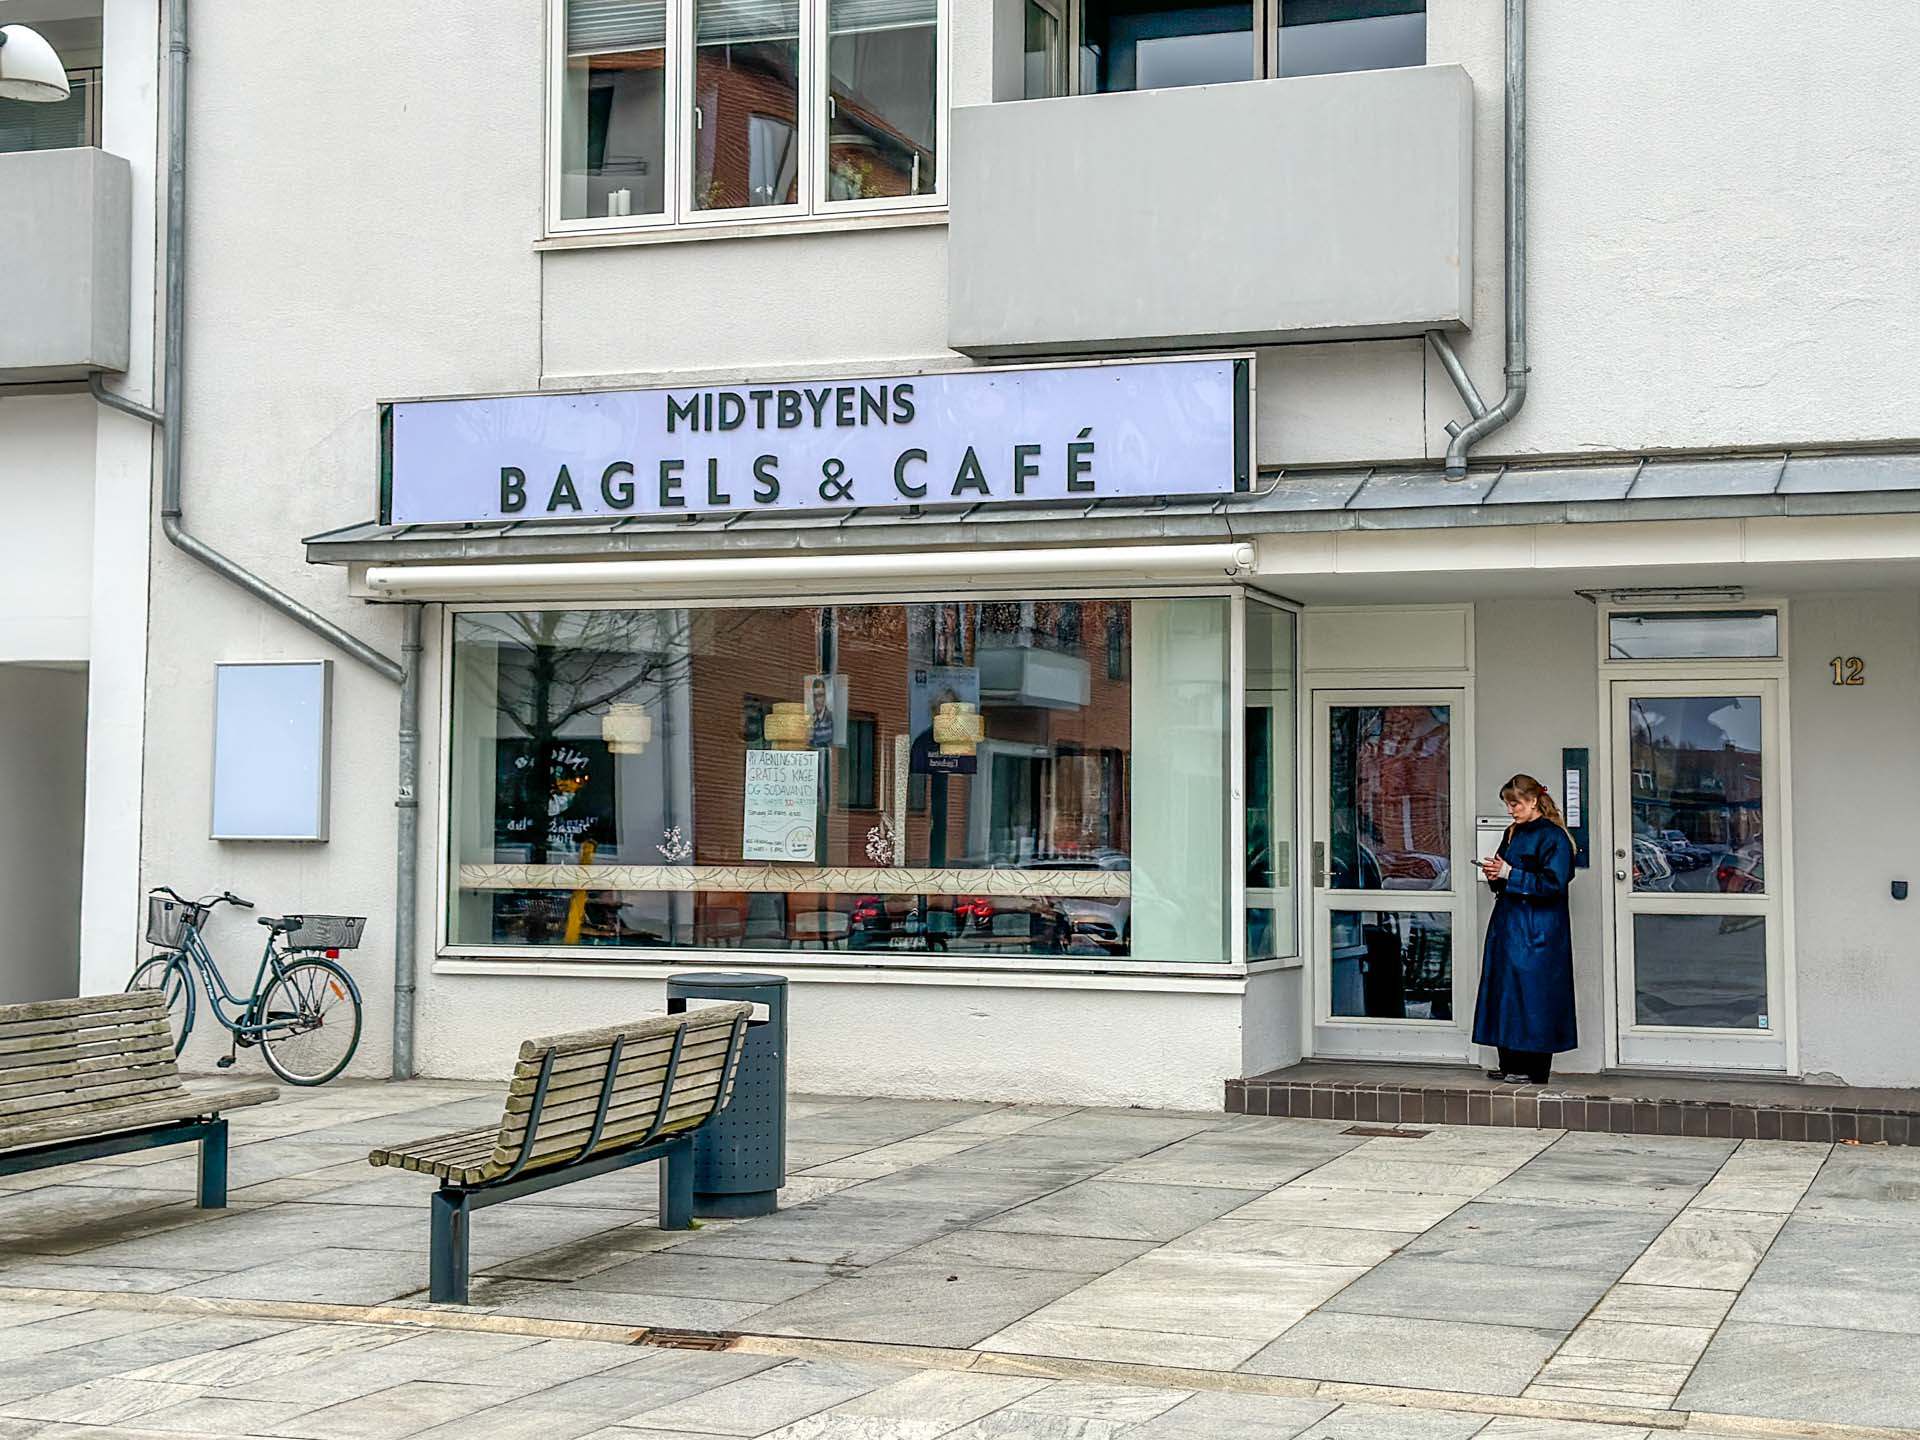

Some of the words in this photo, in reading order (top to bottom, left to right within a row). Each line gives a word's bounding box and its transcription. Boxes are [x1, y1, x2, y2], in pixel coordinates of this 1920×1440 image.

[667, 383, 915, 433] MIDTBYENS
[500, 454, 780, 513] BAGELS
[818, 457, 855, 502] &
[894, 427, 1095, 499] CAFÉ
[1829, 656, 1864, 685] 12
[747, 767, 786, 783] GRATIS
[792, 768, 815, 783] KAGE
